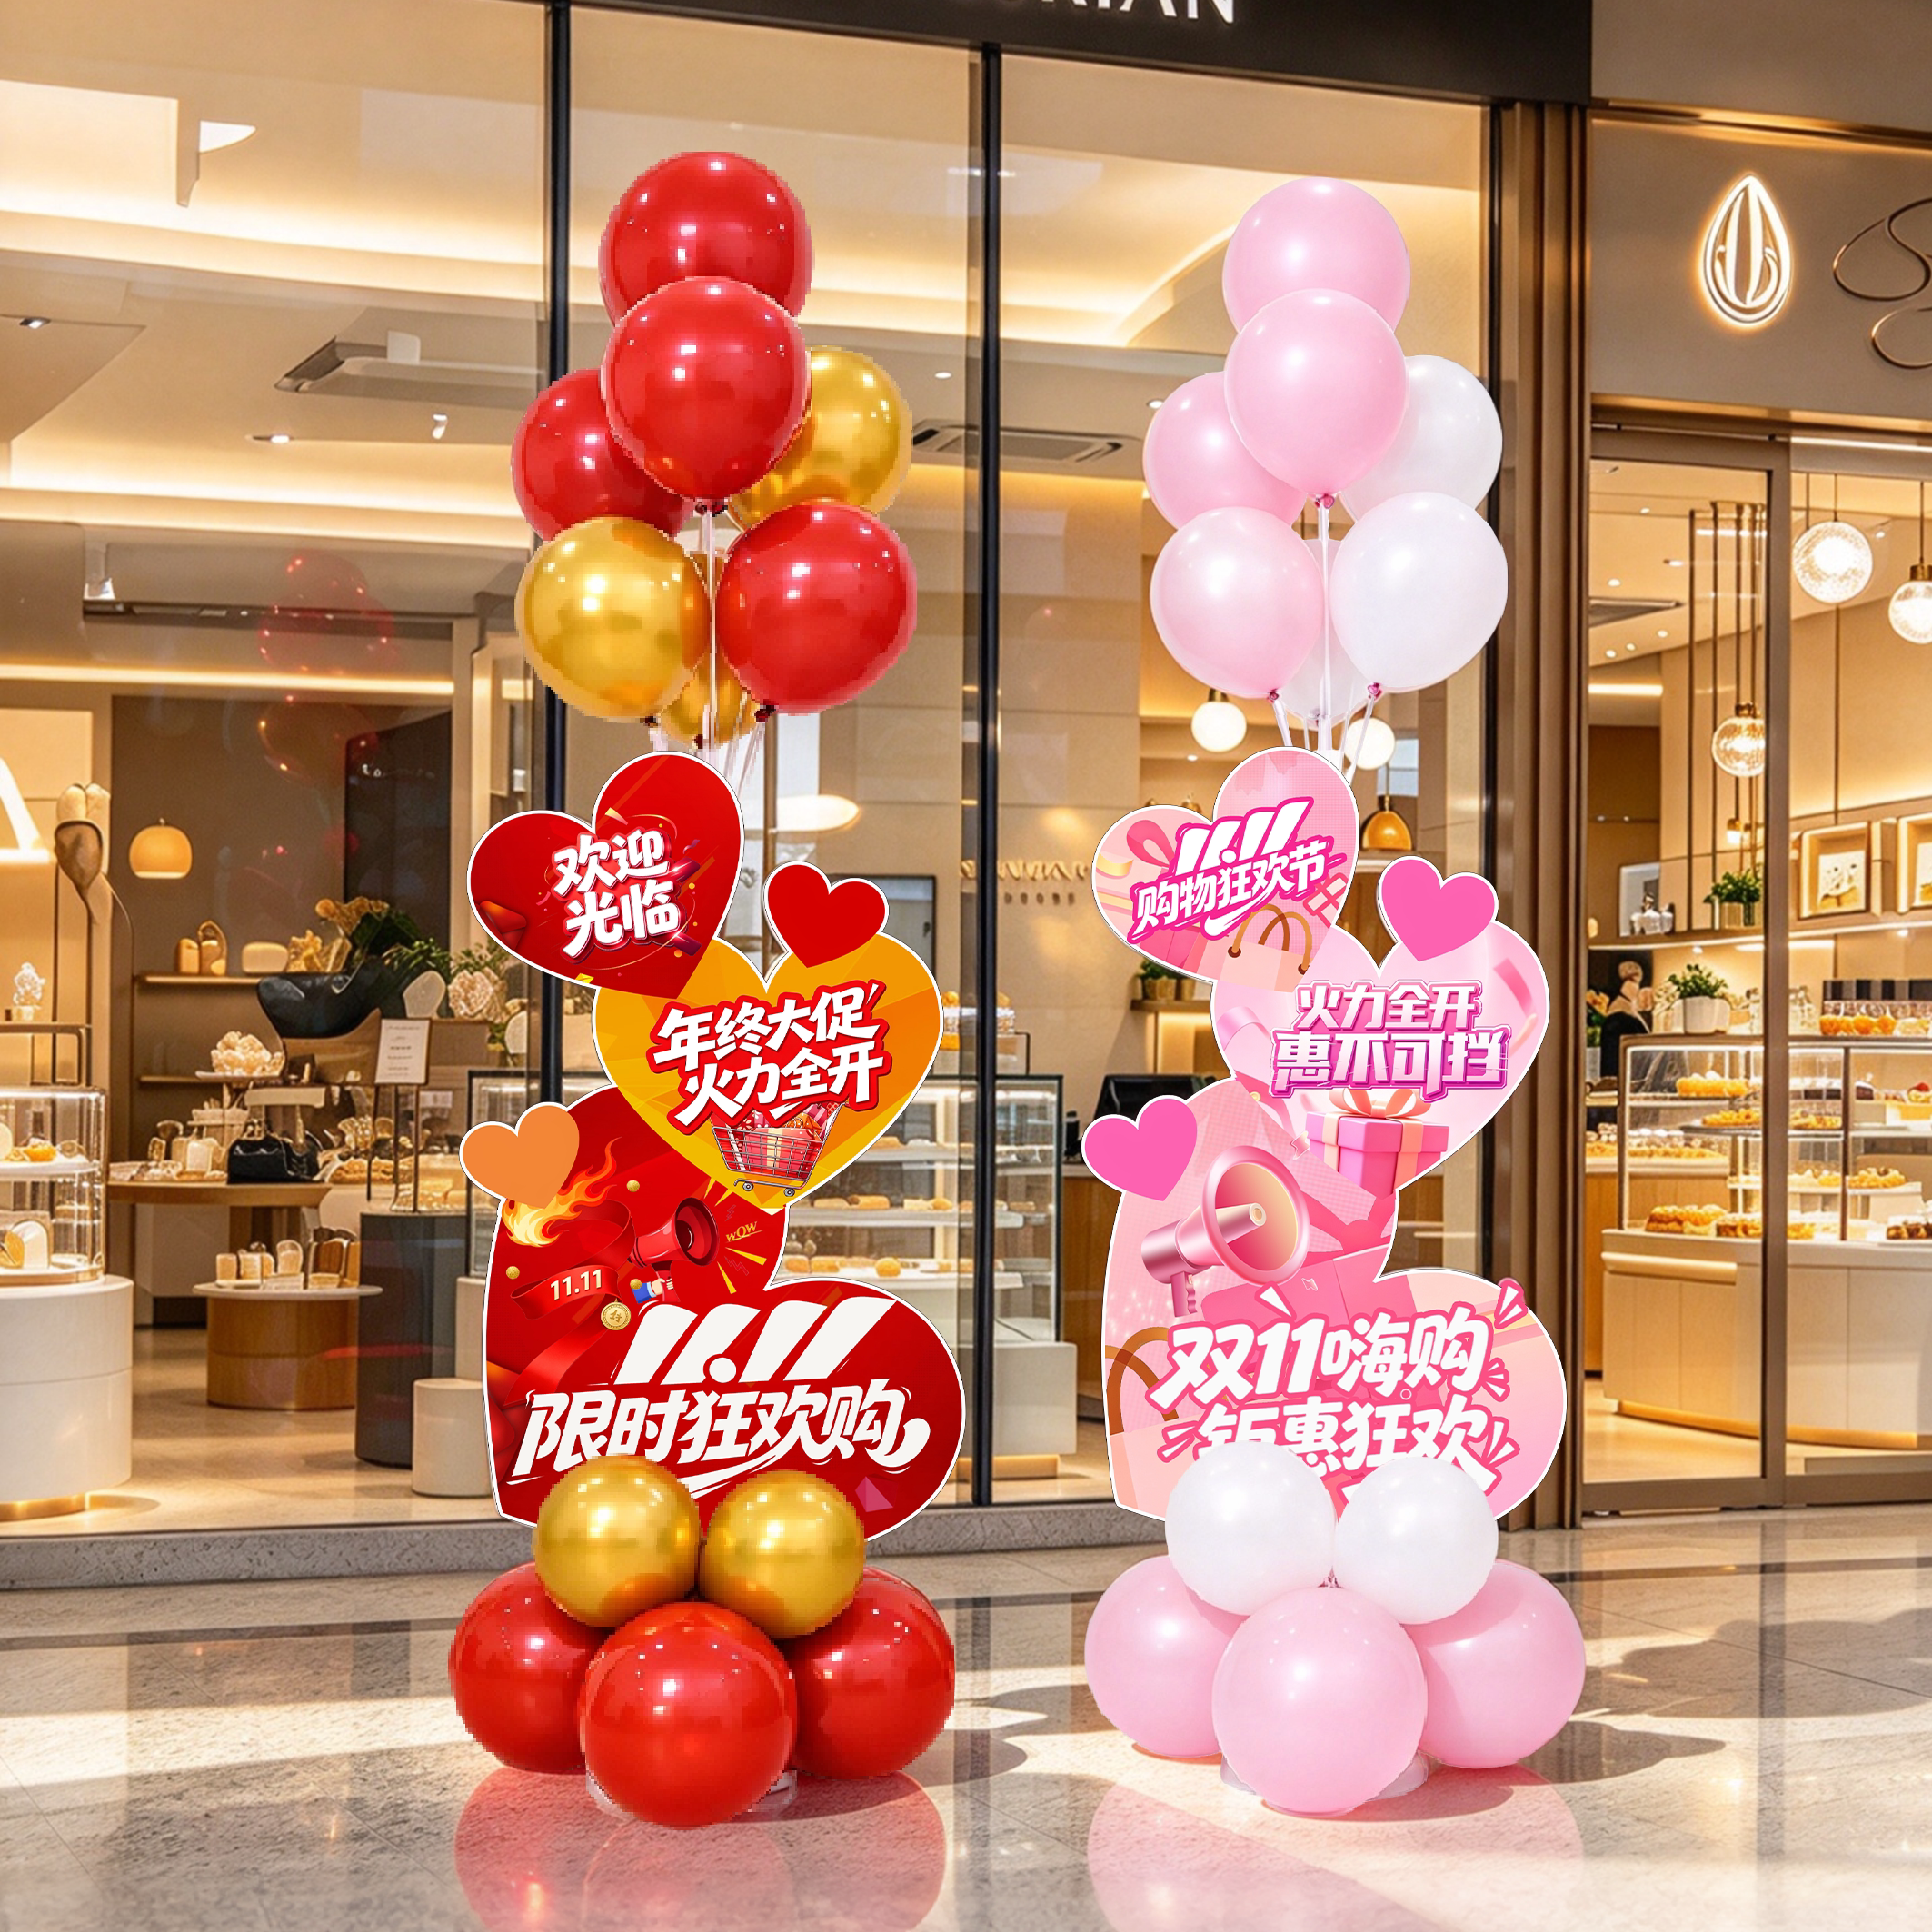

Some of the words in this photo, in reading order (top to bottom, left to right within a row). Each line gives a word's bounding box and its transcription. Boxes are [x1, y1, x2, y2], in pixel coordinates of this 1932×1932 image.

[553, 829, 670, 896] 欢迎
[1175, 800, 1310, 877] 11.11
[562, 878, 680, 958] 光临
[1133, 839, 1329, 936] 购物狂欢节
[653, 983, 881, 1071] 年终大促
[1296, 983, 1477, 1031] 火力全开
[674, 1041, 884, 1128] 火力全开
[1272, 1030, 1511, 1100] 惠不可挡
[549, 1269, 602, 1300] 11.11
[613, 1296, 897, 1385] 11.11
[1149, 1306, 1489, 1412] 双11嗨购
[512, 1378, 933, 1477] 限时狂欢购
